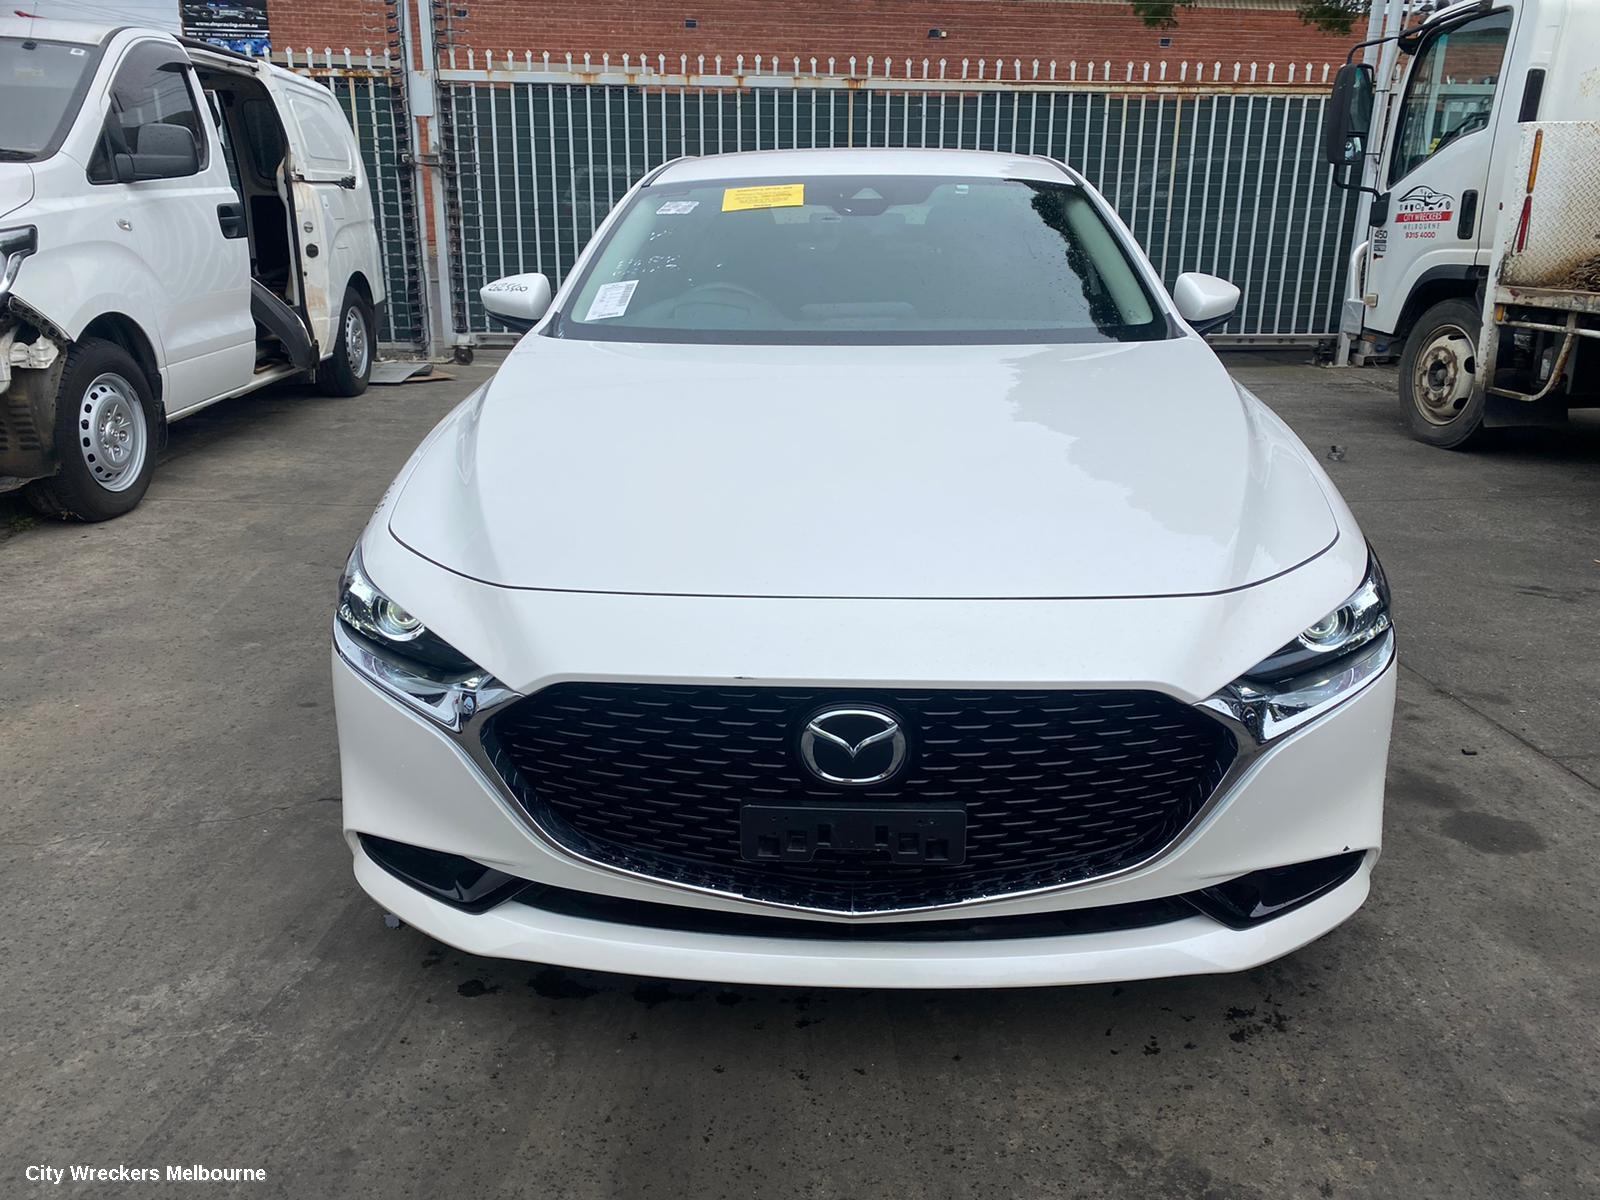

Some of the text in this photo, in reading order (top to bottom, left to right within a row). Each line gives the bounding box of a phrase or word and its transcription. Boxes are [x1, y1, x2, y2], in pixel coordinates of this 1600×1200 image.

[1403, 212, 1442, 222] CITY WRECKERS
[1374, 230, 1388, 239] 450
